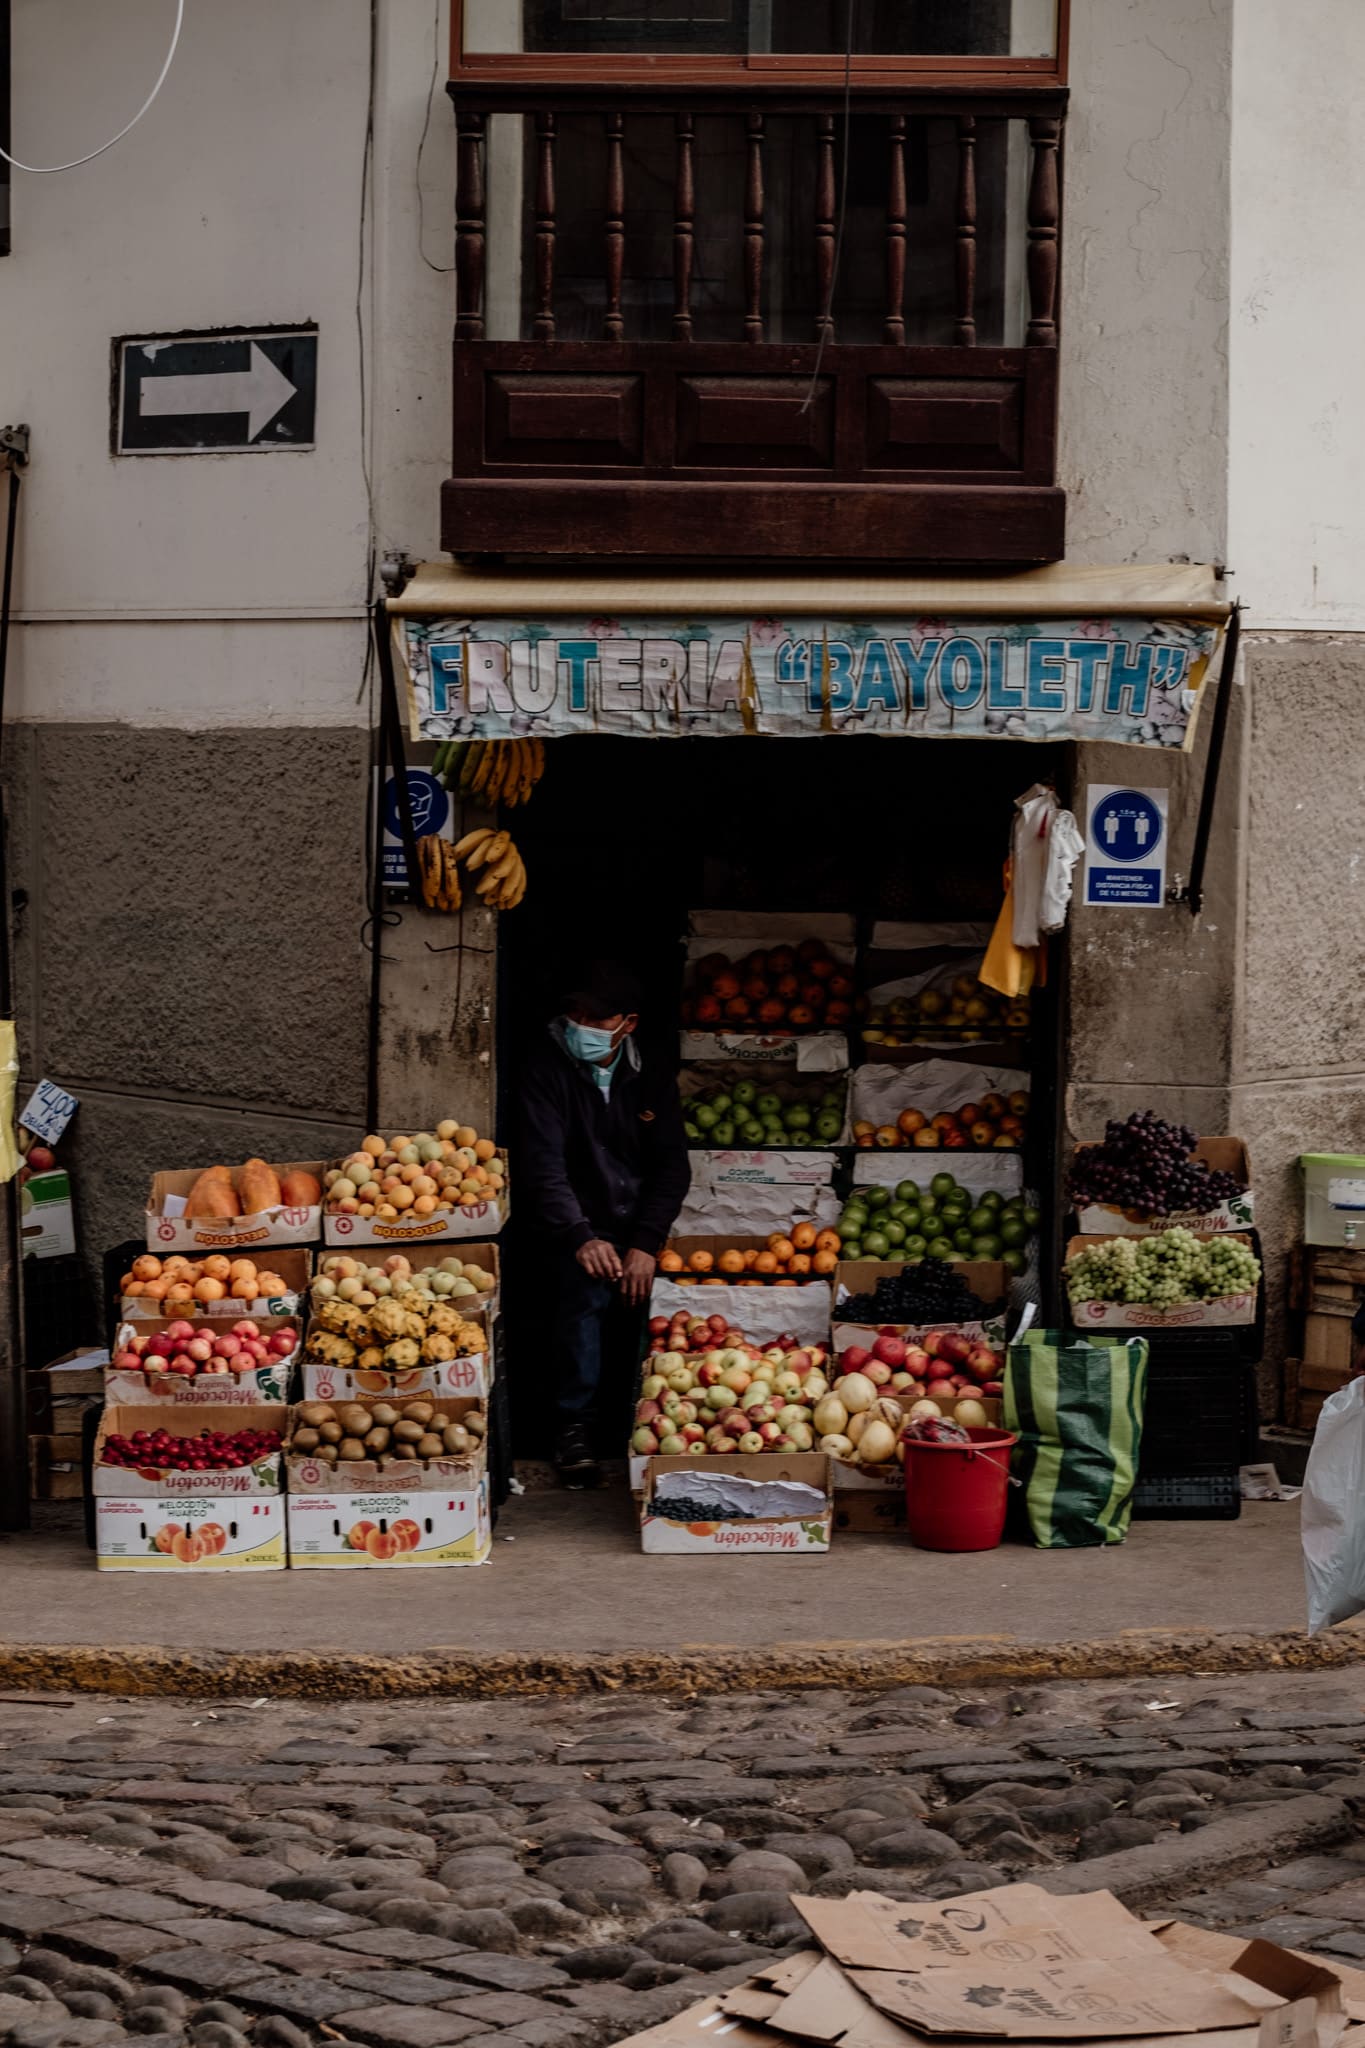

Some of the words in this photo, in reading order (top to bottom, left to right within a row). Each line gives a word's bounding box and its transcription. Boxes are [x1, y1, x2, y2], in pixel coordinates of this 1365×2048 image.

[426, 638, 762, 714] FRUTERIA
[1095, 881, 1130, 889] DISTANCIA
[713, 1531, 800, 1548] Melocotón
